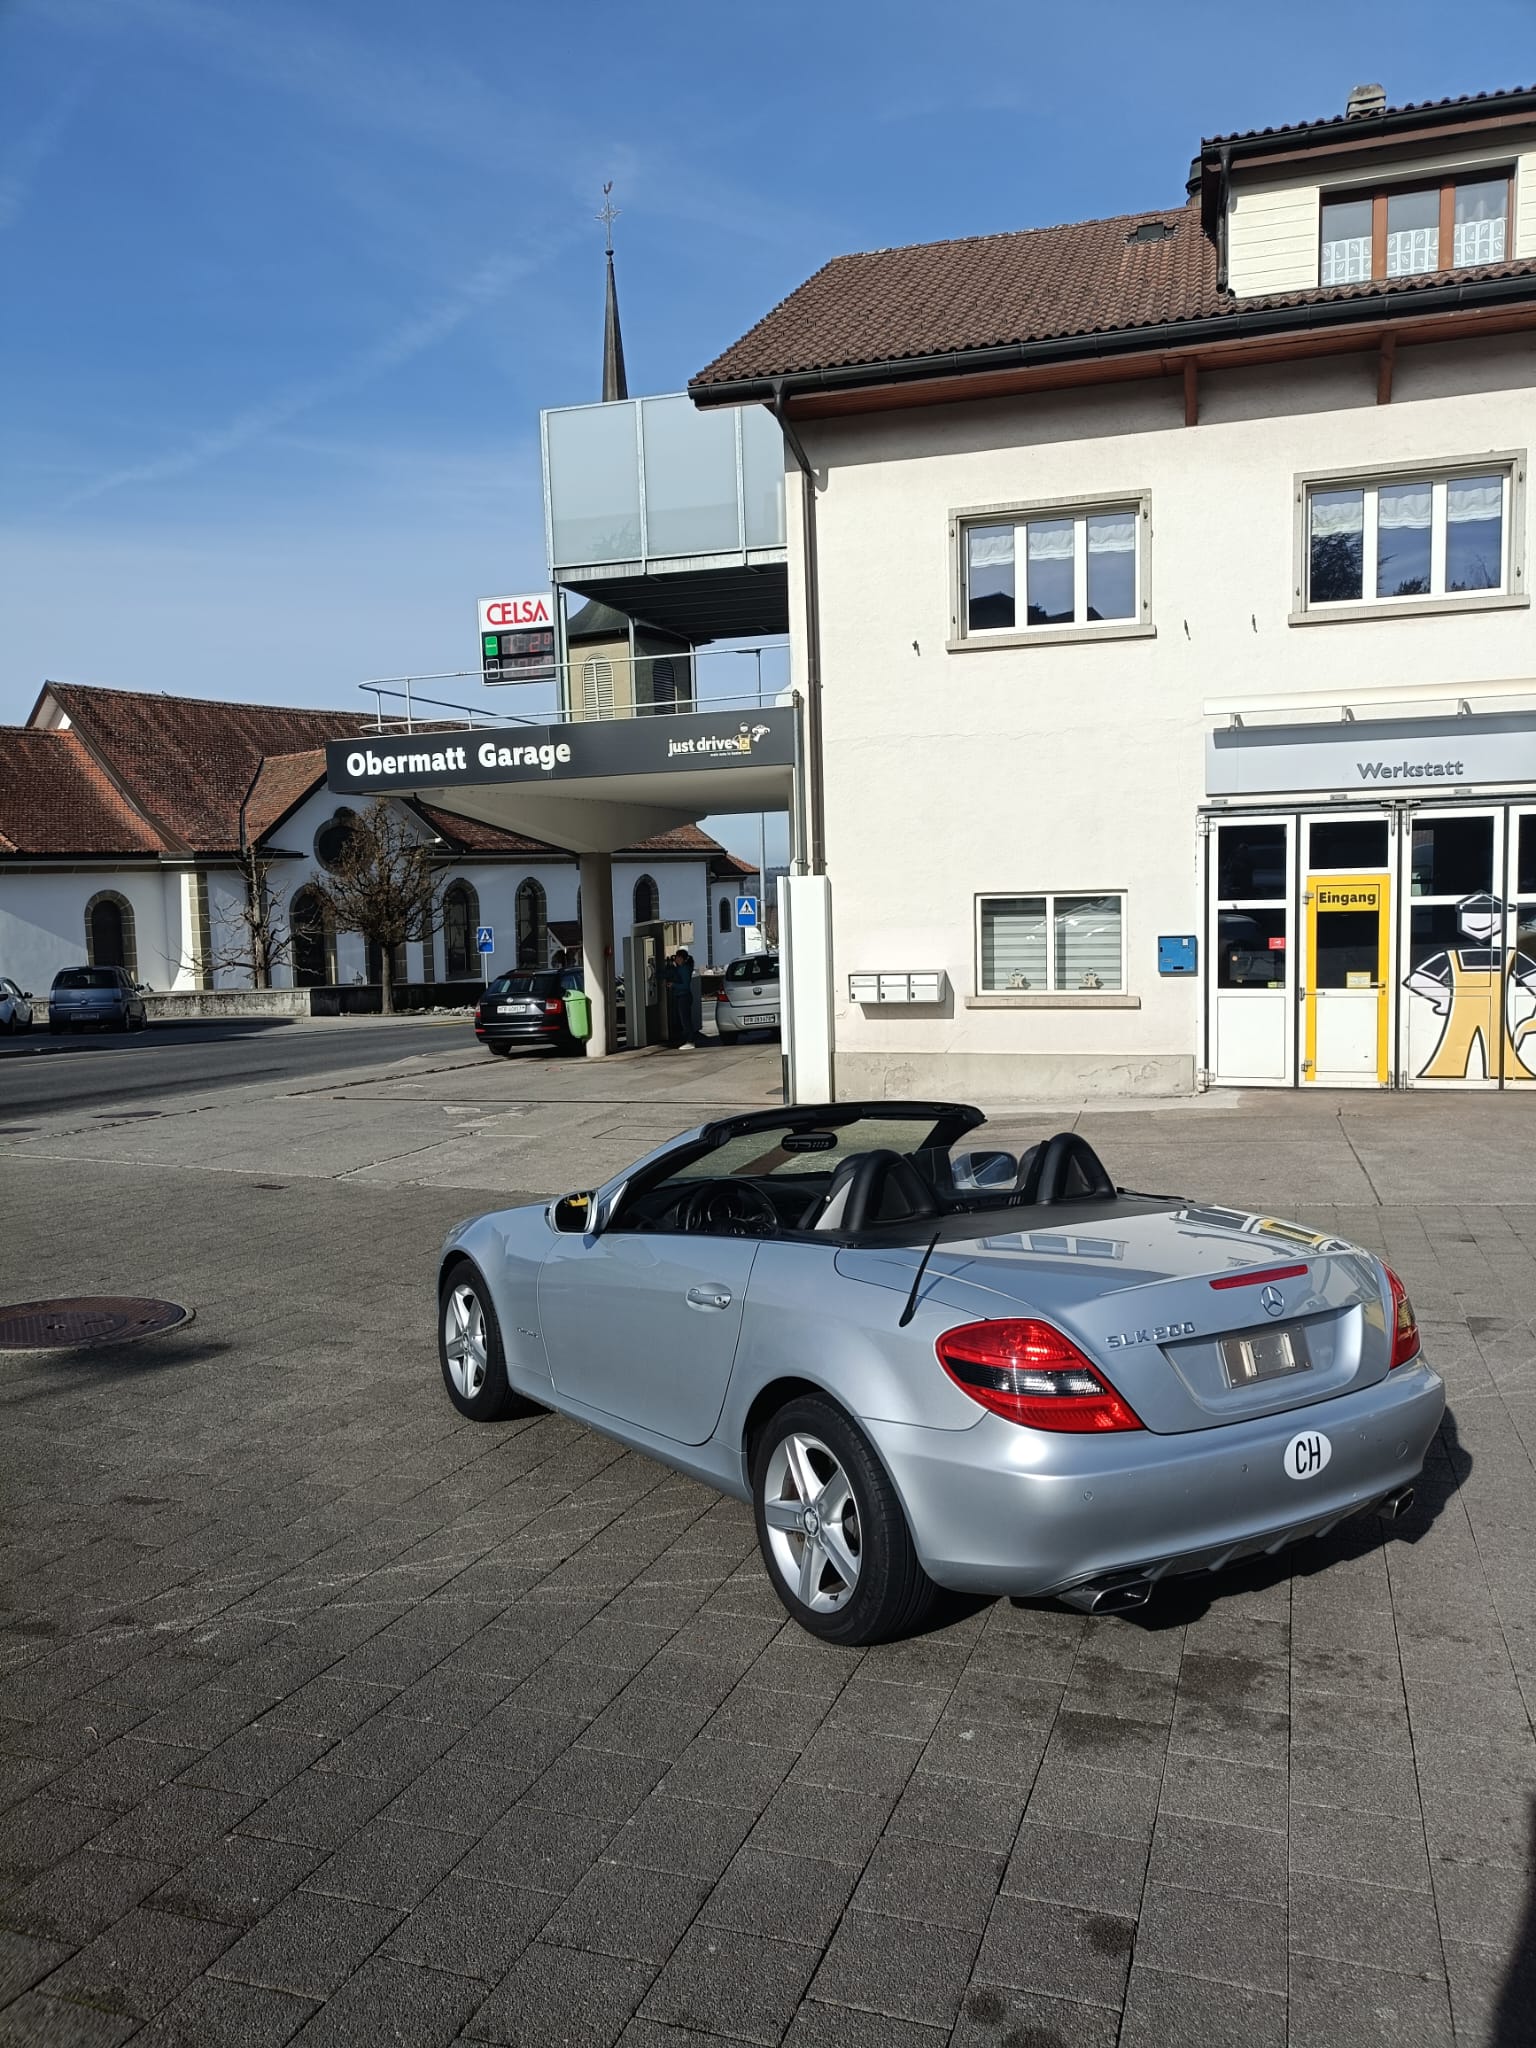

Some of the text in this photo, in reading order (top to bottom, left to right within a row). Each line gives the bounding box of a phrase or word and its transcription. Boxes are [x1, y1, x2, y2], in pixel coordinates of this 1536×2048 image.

[486, 600, 549, 625] CELSA
[668, 735, 733, 757] just drive
[346, 742, 571, 777] Obermatt Garage
[1357, 760, 1464, 780] Werkstatt
[1318, 890, 1377, 905] Eingang
[1105, 1321, 1195, 1348] SLK 200
[1295, 1436, 1321, 1474] CH
